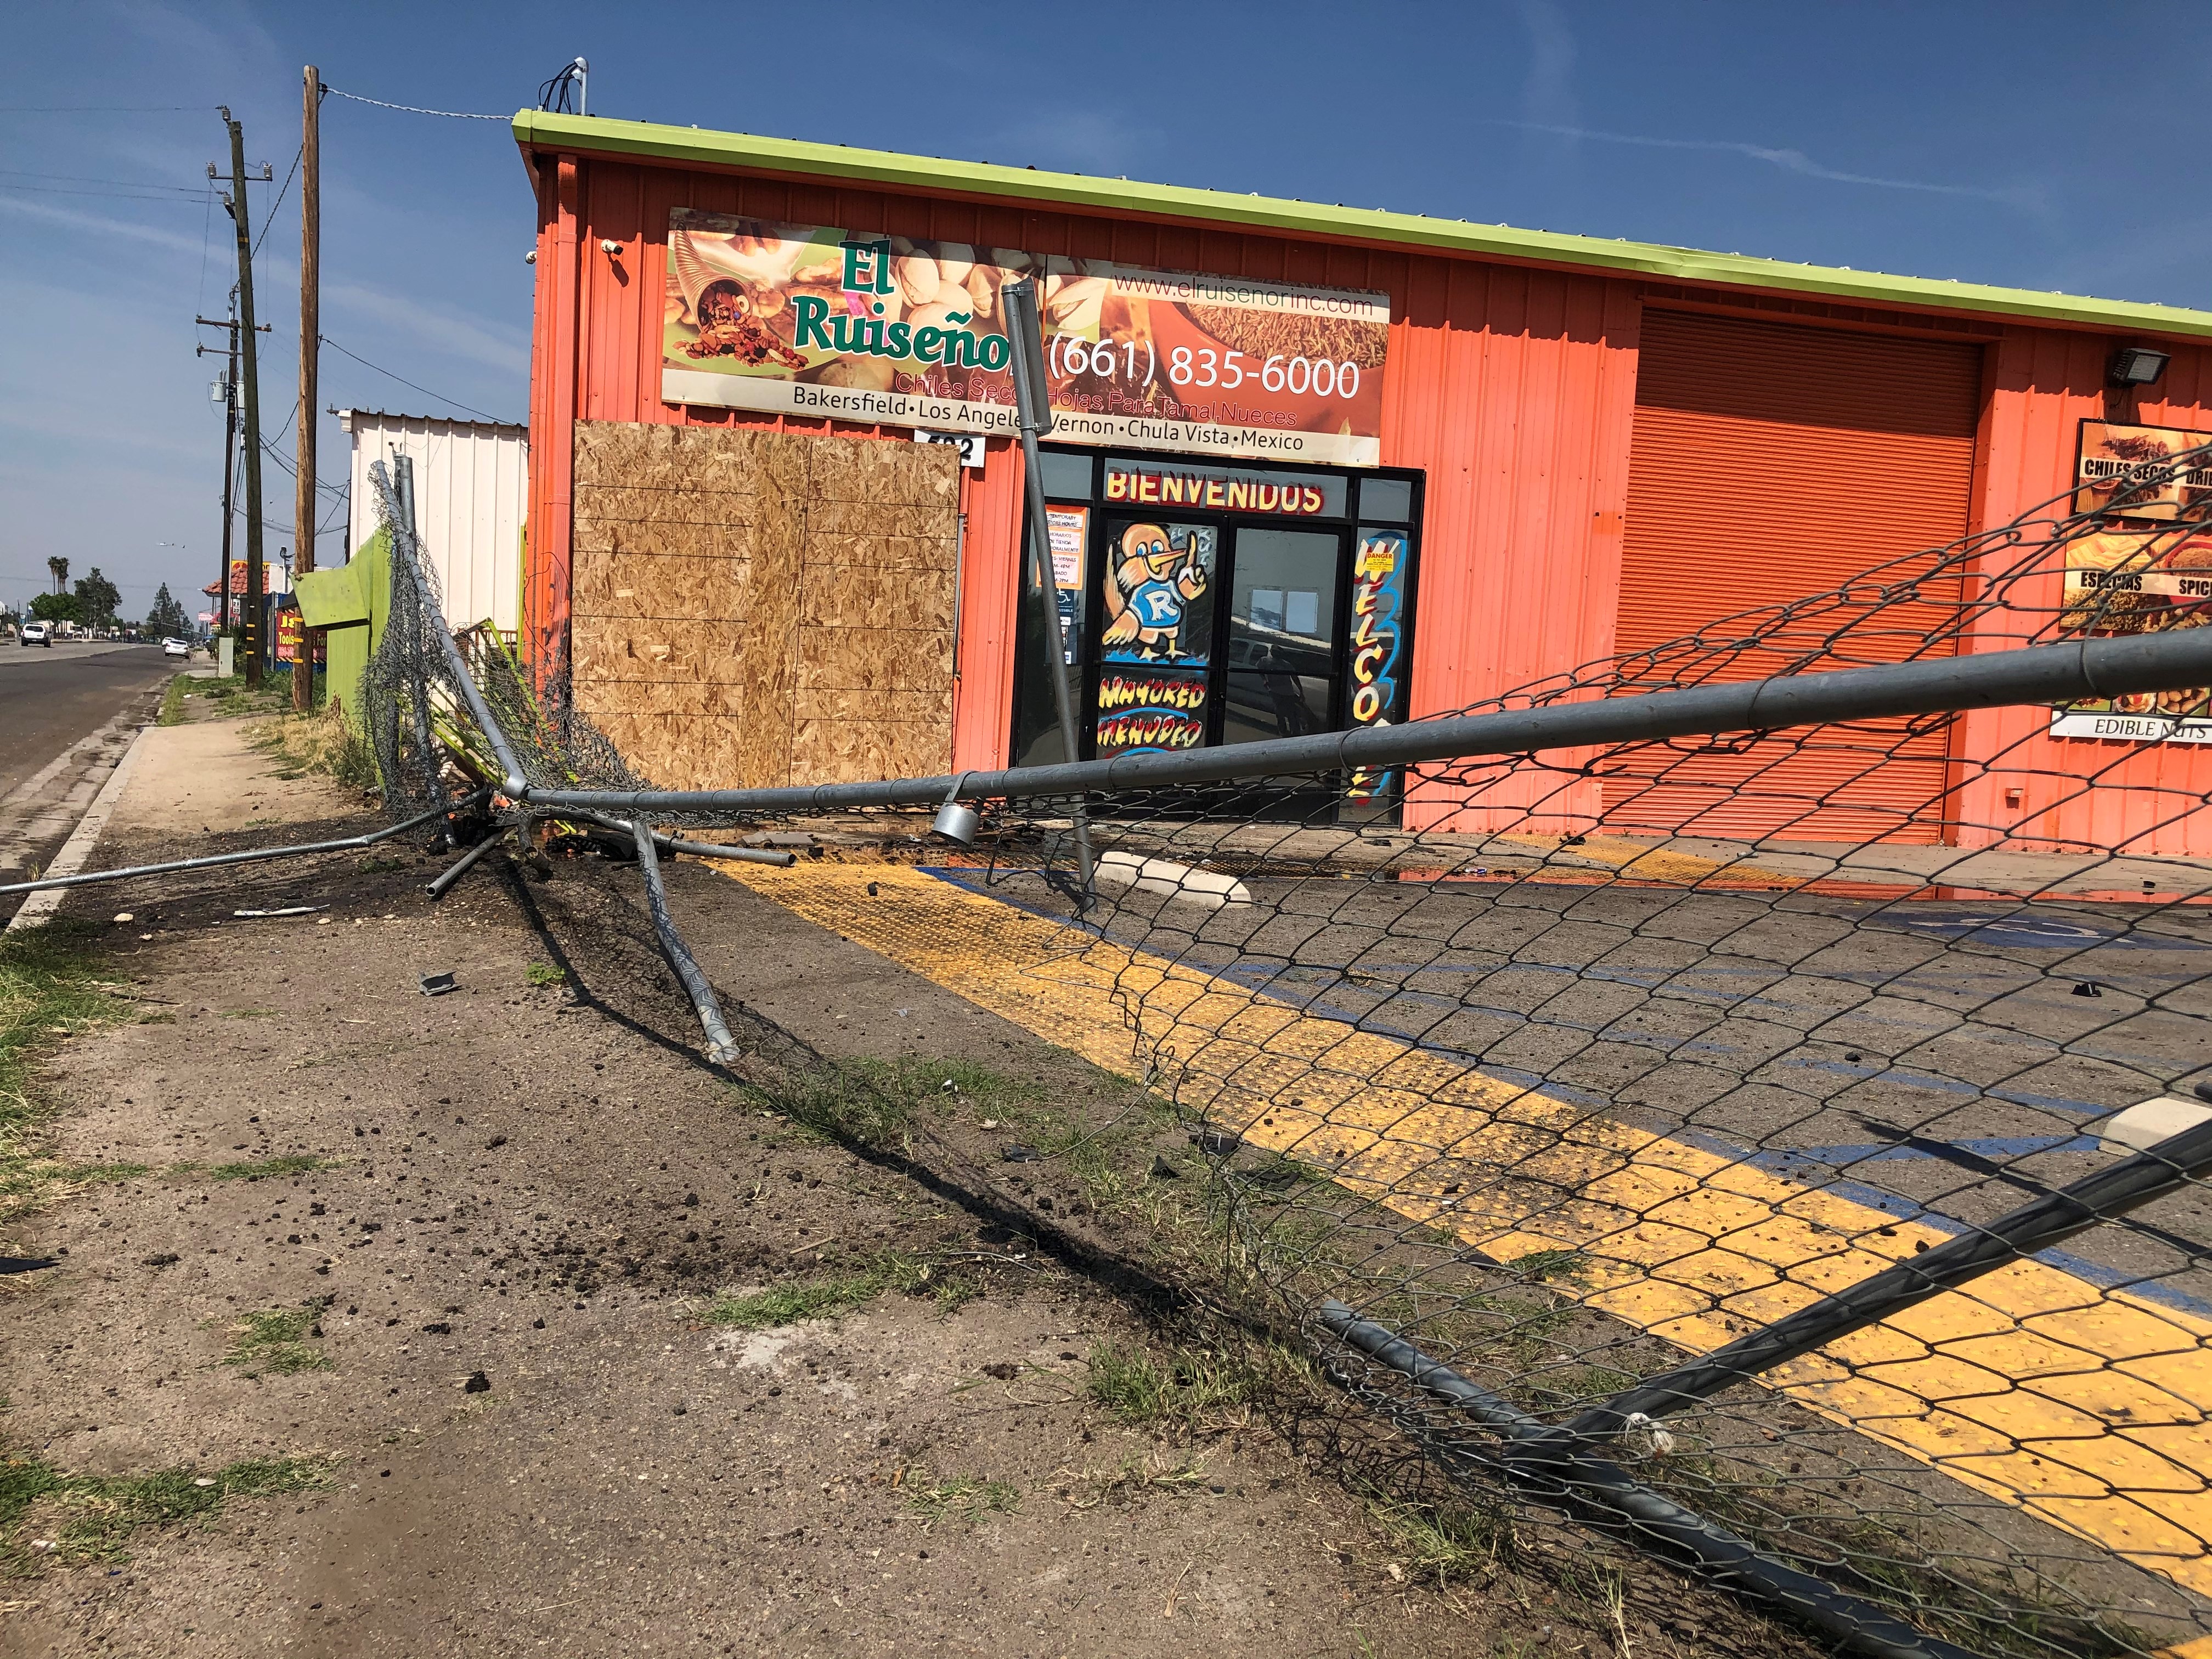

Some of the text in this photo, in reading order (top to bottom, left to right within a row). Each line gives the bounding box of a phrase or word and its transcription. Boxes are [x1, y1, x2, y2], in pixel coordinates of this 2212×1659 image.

[839, 239, 894, 294] El
[1115, 275, 1373, 315] www.elruisenorinc.com
[792, 295, 1014, 373] Ruiseño
[896, 373, 964, 397] Chiles
[1050, 332, 1359, 399] (661) 835-6000
[794, 386, 906, 415] Bakersfield
[919, 400, 951, 419] Los
[957, 404, 1022, 430] Angele
[1127, 420, 1178, 441] Chula
[1186, 425, 1229, 445] Vista
[1241, 430, 1304, 450] Mexico
[1107, 467, 1323, 514] BIENVENIDOS
[1146, 590, 1177, 620] R
[2179, 579, 2212, 596] SPIC
[278, 631, 294, 645] Tools
[1349, 538, 1400, 801] WELCOE
[2095, 719, 2156, 736] EDIBLE
